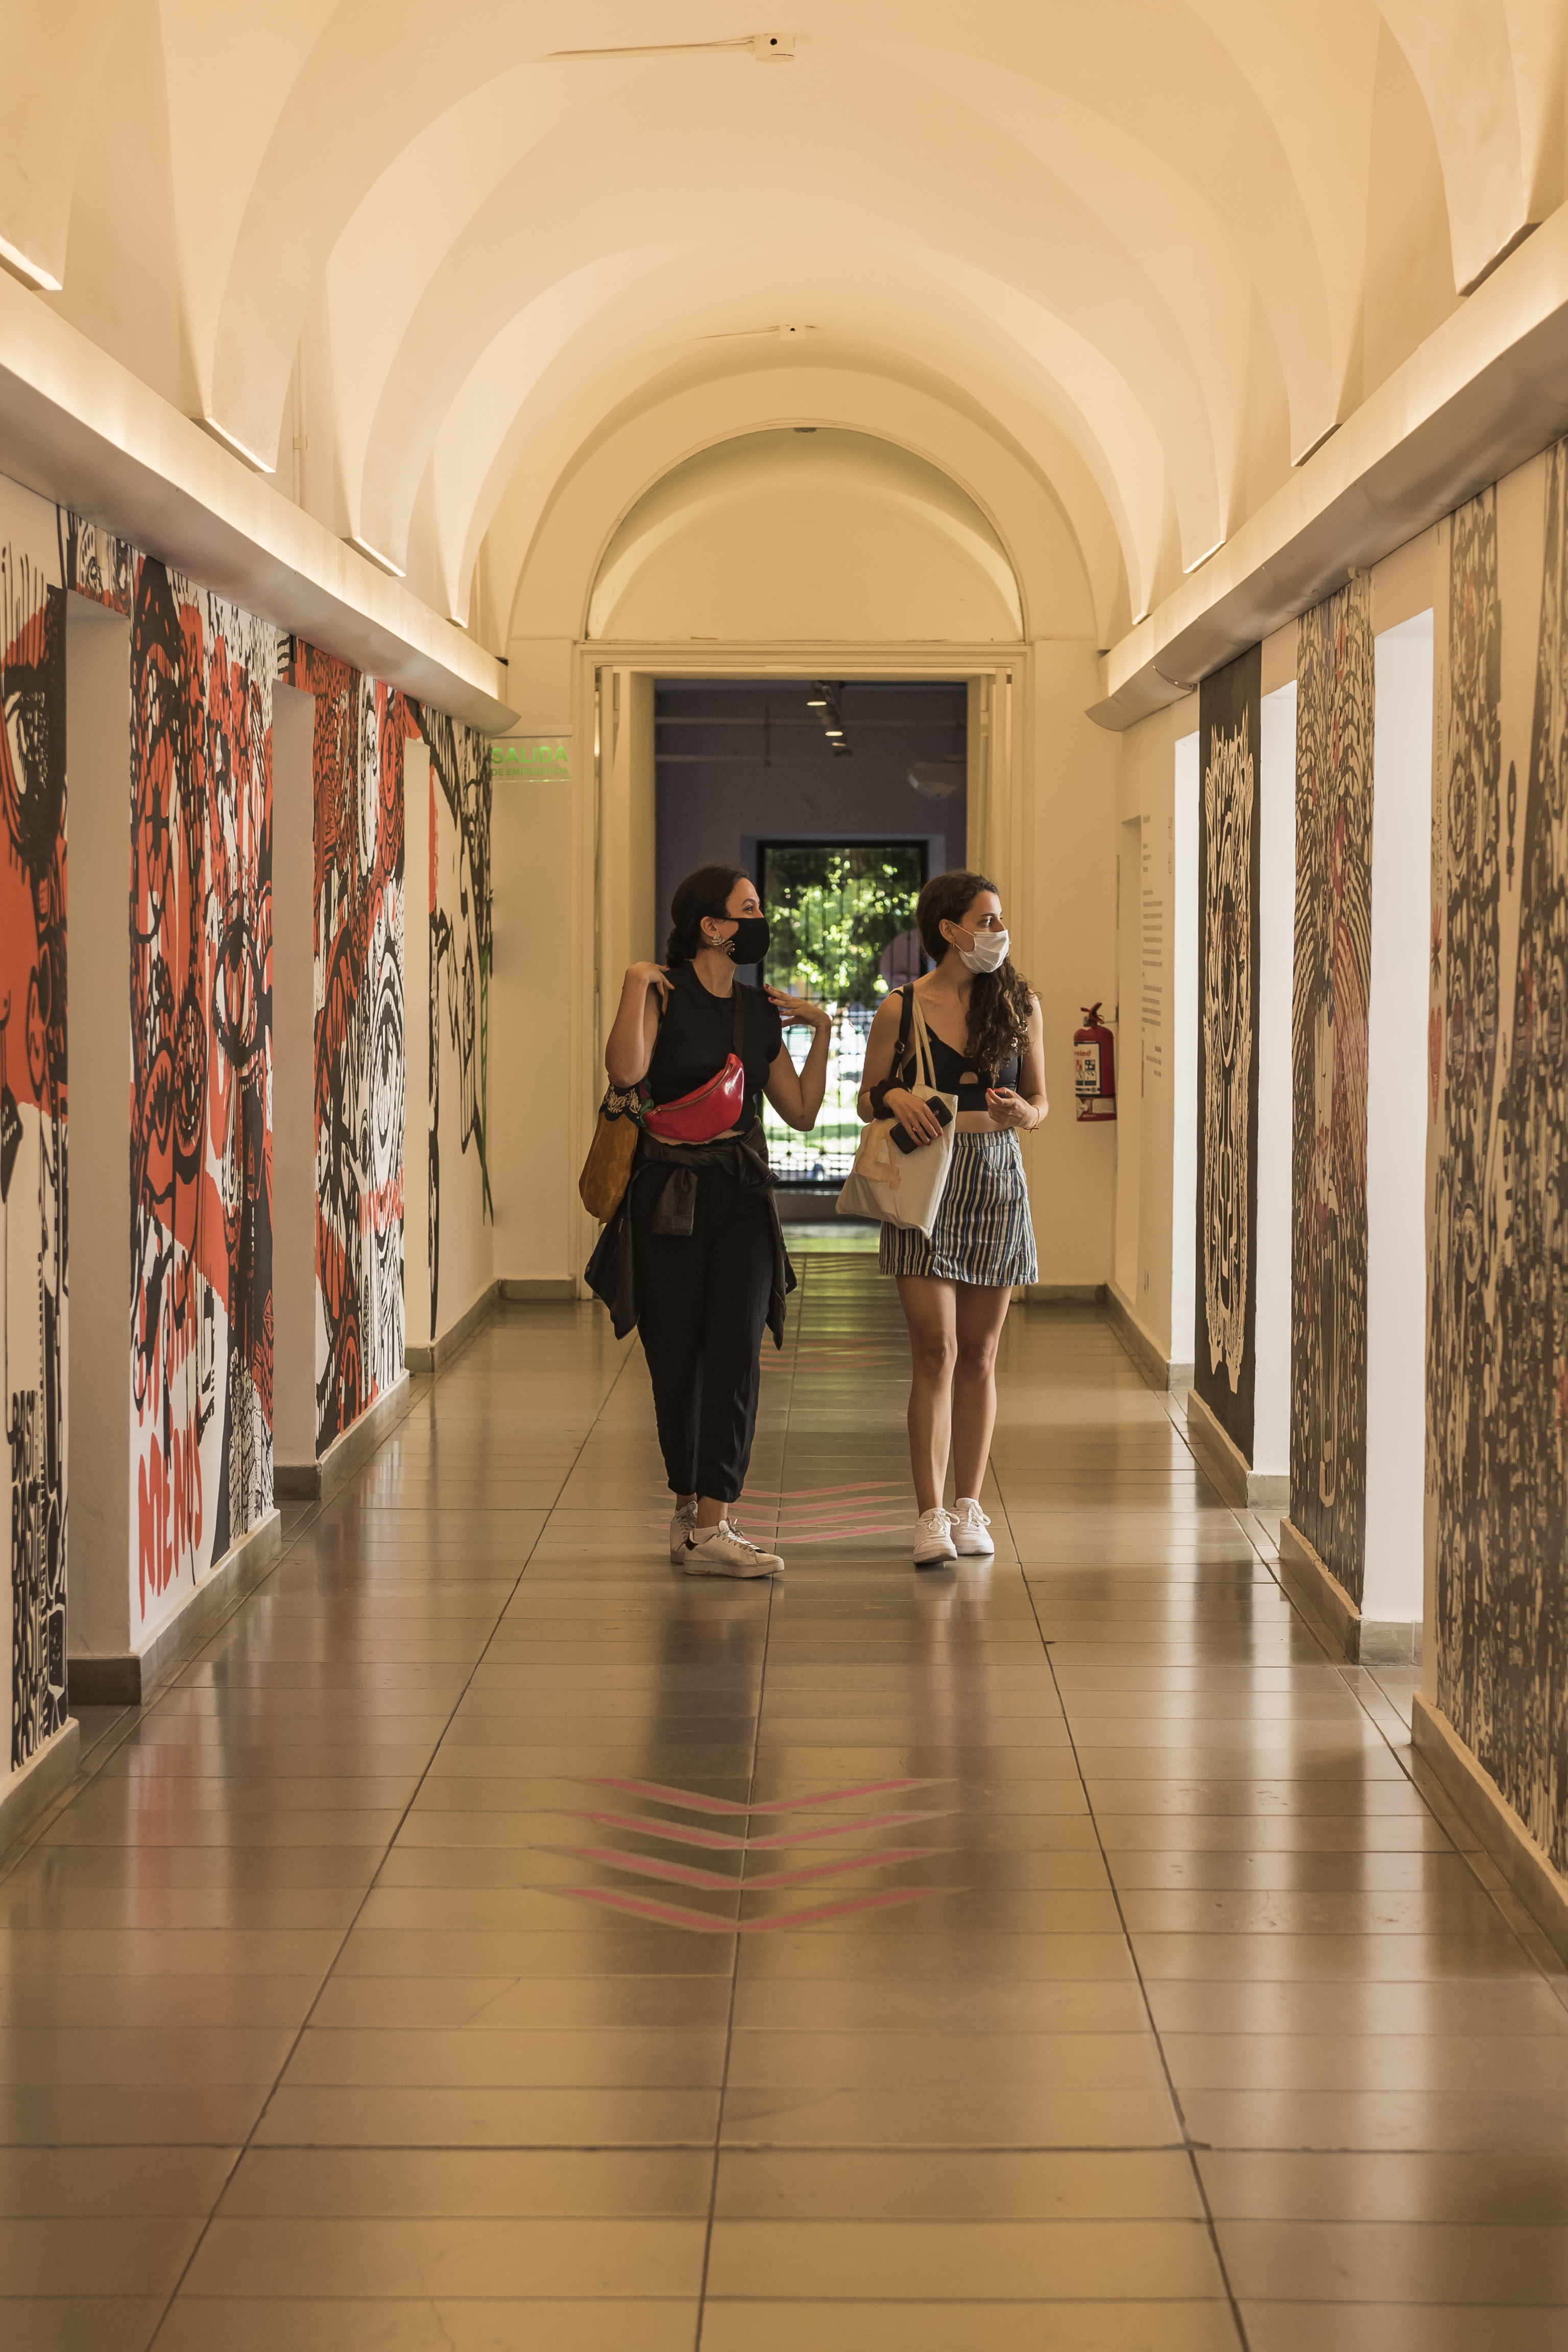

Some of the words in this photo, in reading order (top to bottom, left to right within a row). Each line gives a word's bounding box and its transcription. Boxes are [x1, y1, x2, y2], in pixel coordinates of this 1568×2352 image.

[491, 746, 568, 764] SALIDA
[491, 768, 504, 776] DE
[506, 767, 569, 776] EMERGENCIA
[138, 1396, 203, 1624] MENOS
